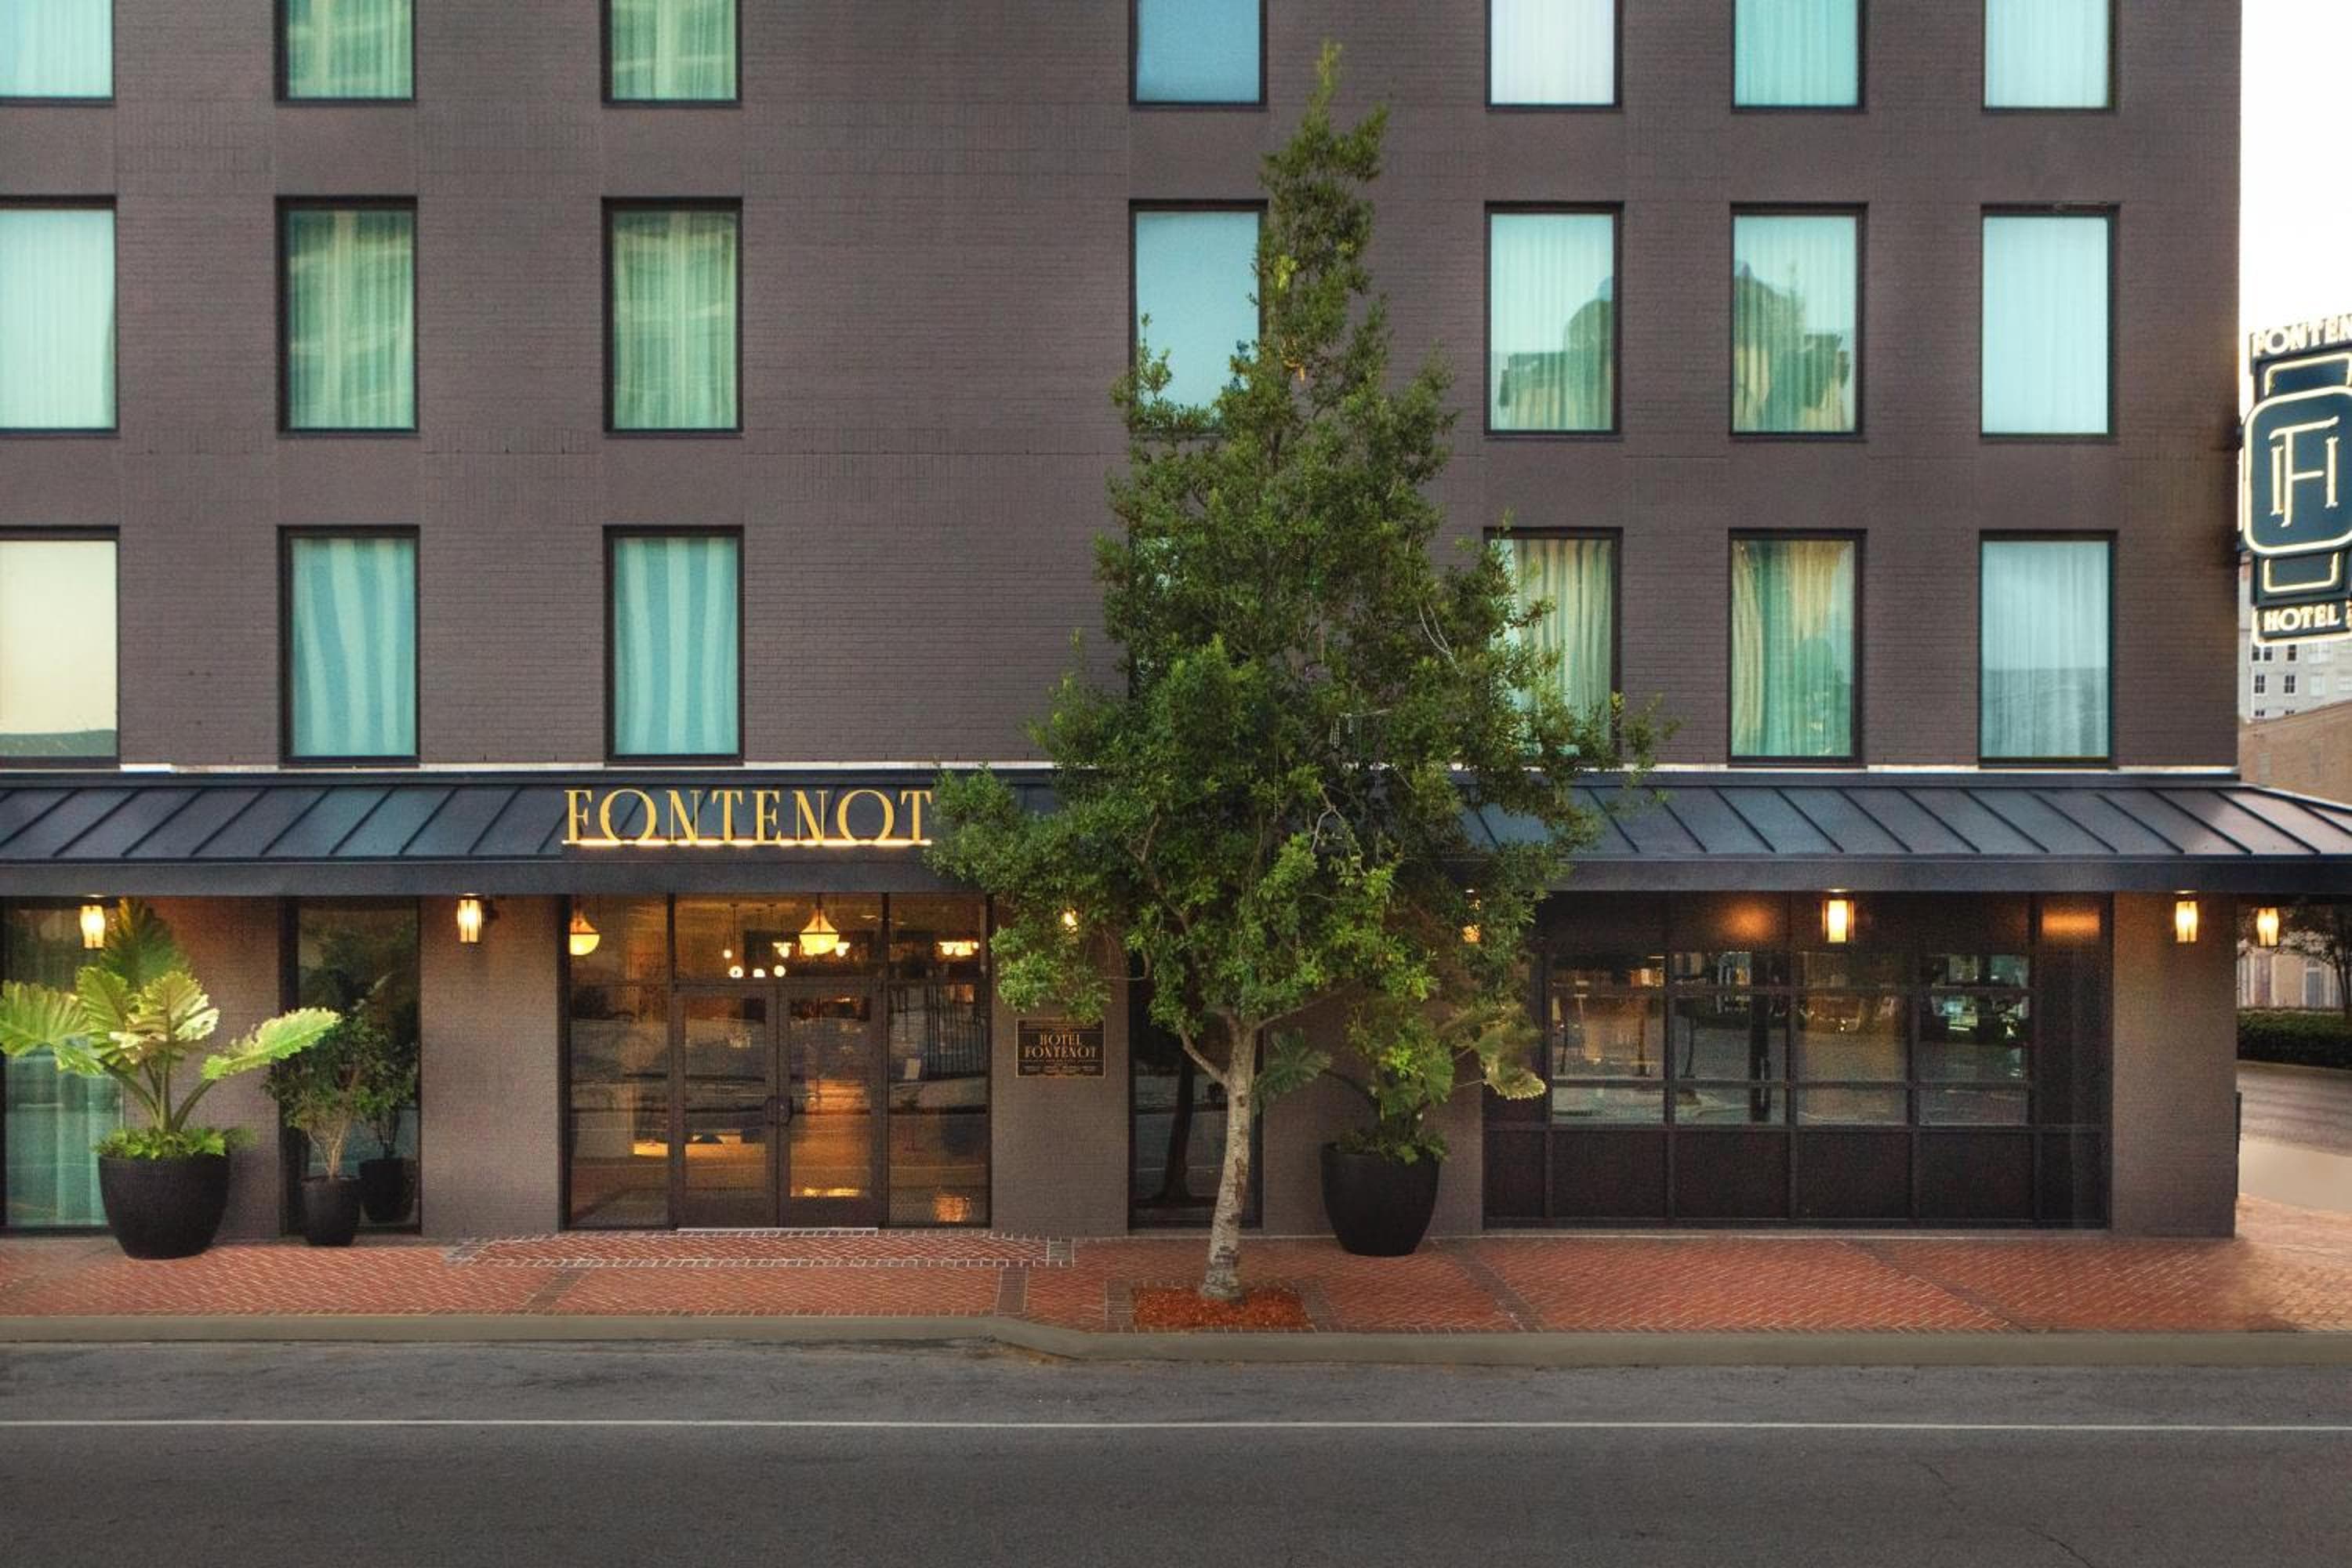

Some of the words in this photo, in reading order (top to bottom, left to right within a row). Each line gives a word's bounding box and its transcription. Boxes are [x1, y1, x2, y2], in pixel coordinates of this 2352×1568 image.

[2263, 602, 2340, 631] HOTEL
[564, 788, 932, 844] FONTENOT
[1040, 1033, 1080, 1046] HOTEL
[1025, 1045, 1097, 1058] FONTENOT
